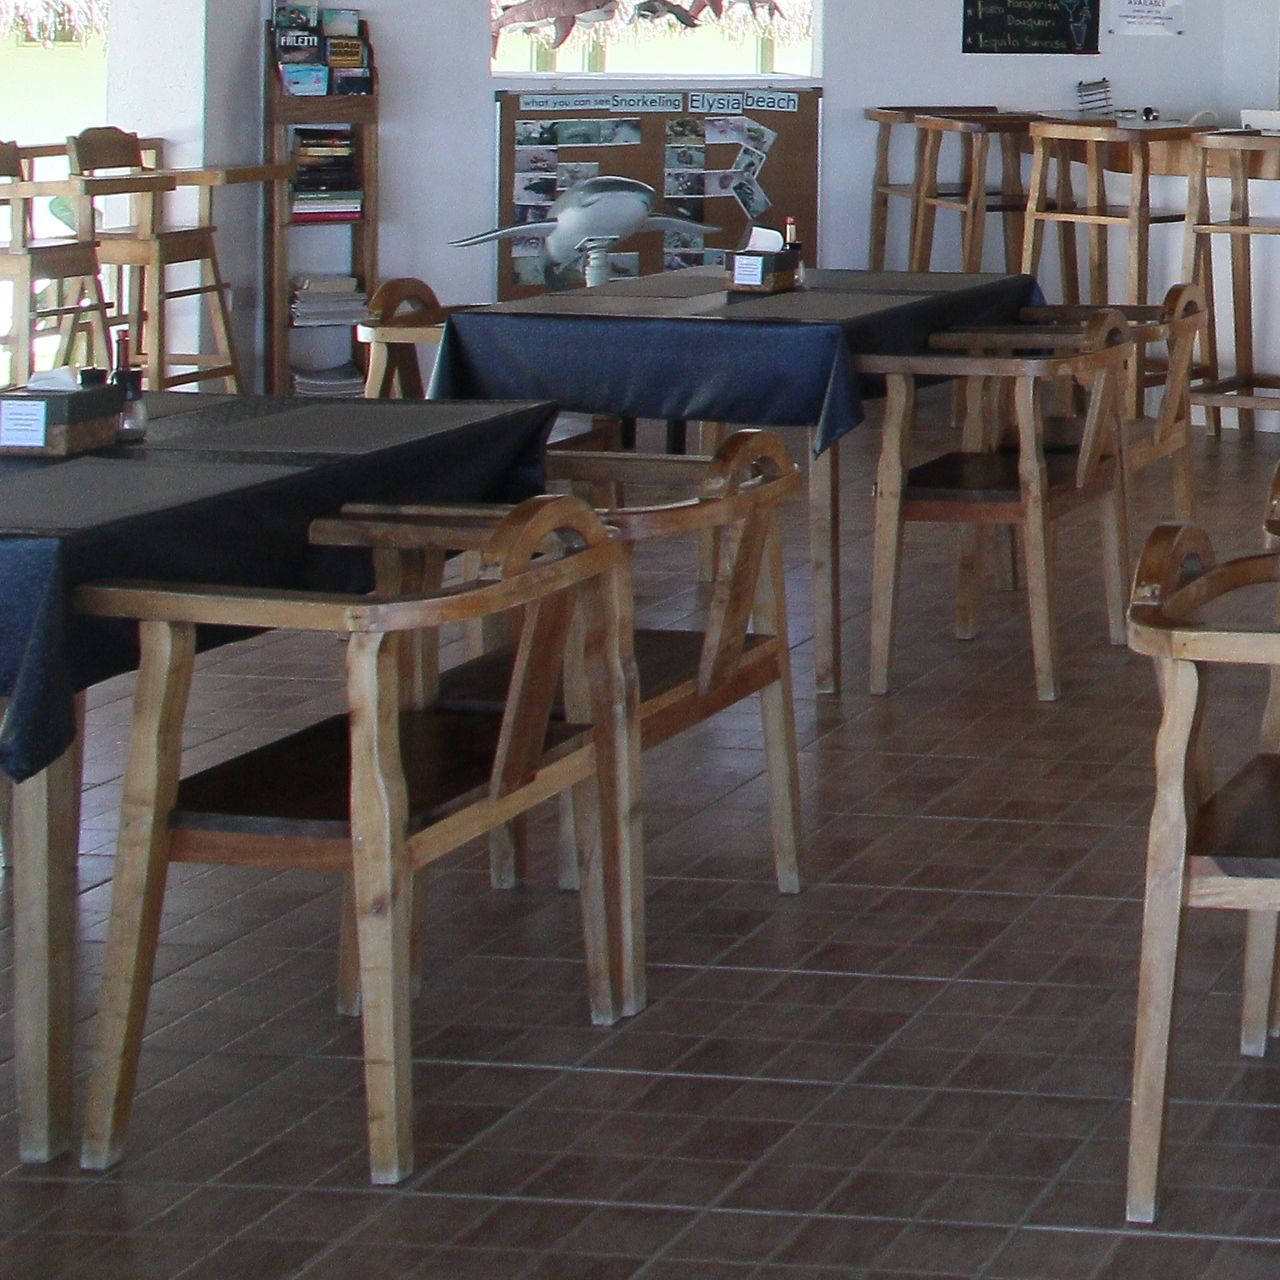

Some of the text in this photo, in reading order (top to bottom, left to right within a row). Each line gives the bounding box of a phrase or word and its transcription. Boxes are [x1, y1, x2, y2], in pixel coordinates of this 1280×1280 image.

[524, 98, 549, 107] what
[553, 99, 570, 108] you
[594, 98, 611, 106] see
[612, 95, 681, 109] Snorkeling
[690, 93, 740, 111] Elysia
[745, 93, 796, 109] beach
